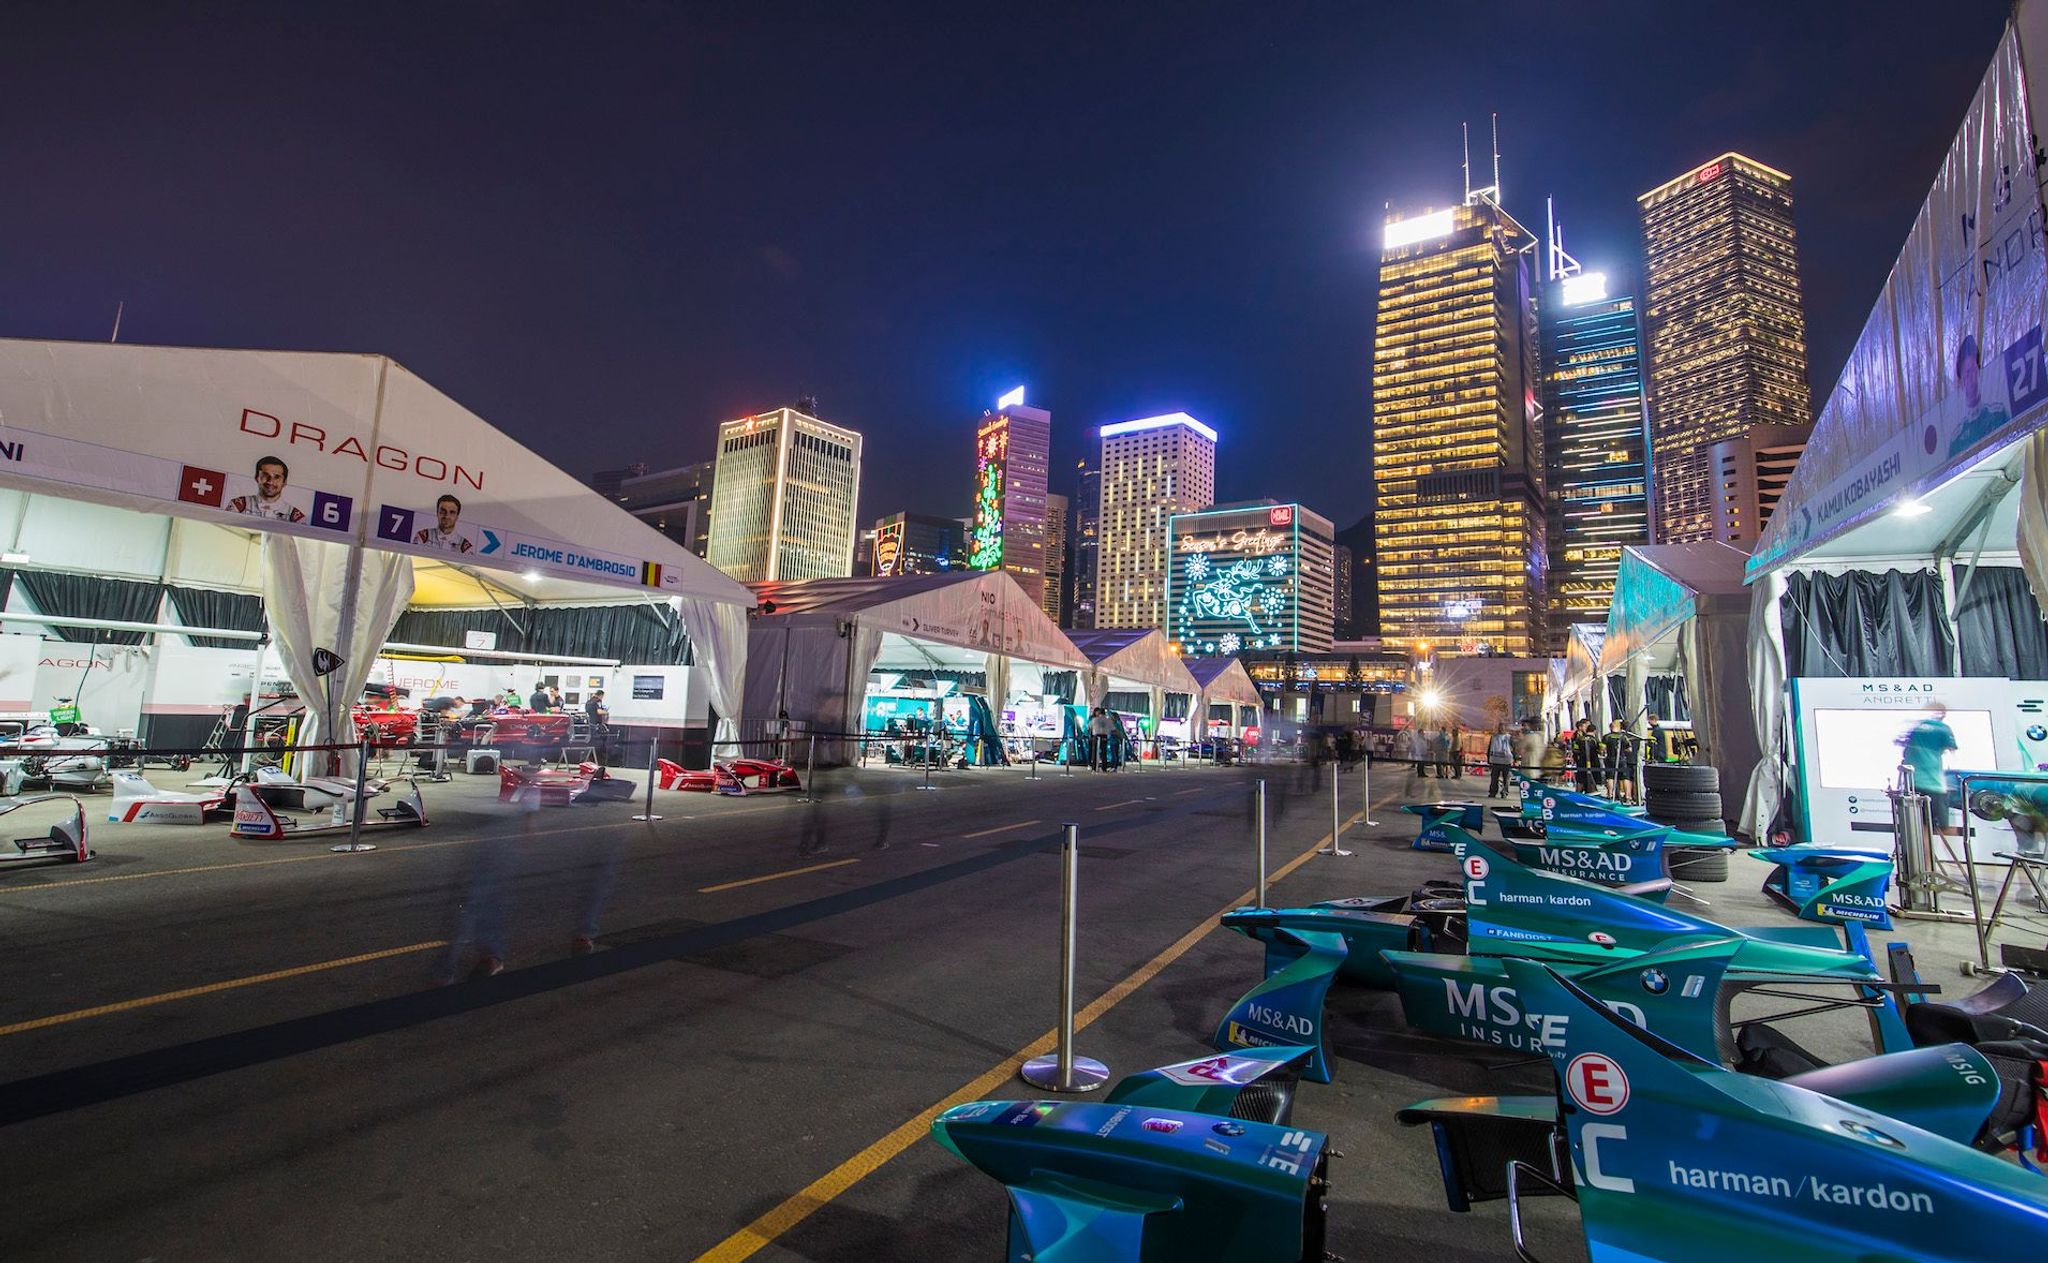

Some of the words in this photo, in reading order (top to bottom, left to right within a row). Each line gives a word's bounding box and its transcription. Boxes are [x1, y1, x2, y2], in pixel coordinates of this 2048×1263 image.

[2011, 346, 2040, 395] 27
[240, 407, 485, 491] DRAGON
[1817, 490, 1843, 524] KAMUI
[1845, 452, 1901, 507] KOBAYASHI
[322, 502, 340, 524] 6
[390, 513, 405, 534] 7
[511, 543, 563, 564] JEROME
[567, 555, 637, 577] D'AMBROSIO
[981, 591, 996, 605] NIO
[397, 677, 459, 690] JEROME
[1862, 684, 1933, 692] MS&AD
[1863, 696, 1938, 704] ANDRETTI
[1542, 808, 1554, 820] B
[1538, 846, 1632, 872] MS&AD
[1832, 893, 1884, 908] MS&AD
[1836, 910, 1880, 920] MICHELIN
[1248, 1003, 1314, 1036] MS&AD
[1582, 1063, 1613, 1104] E
